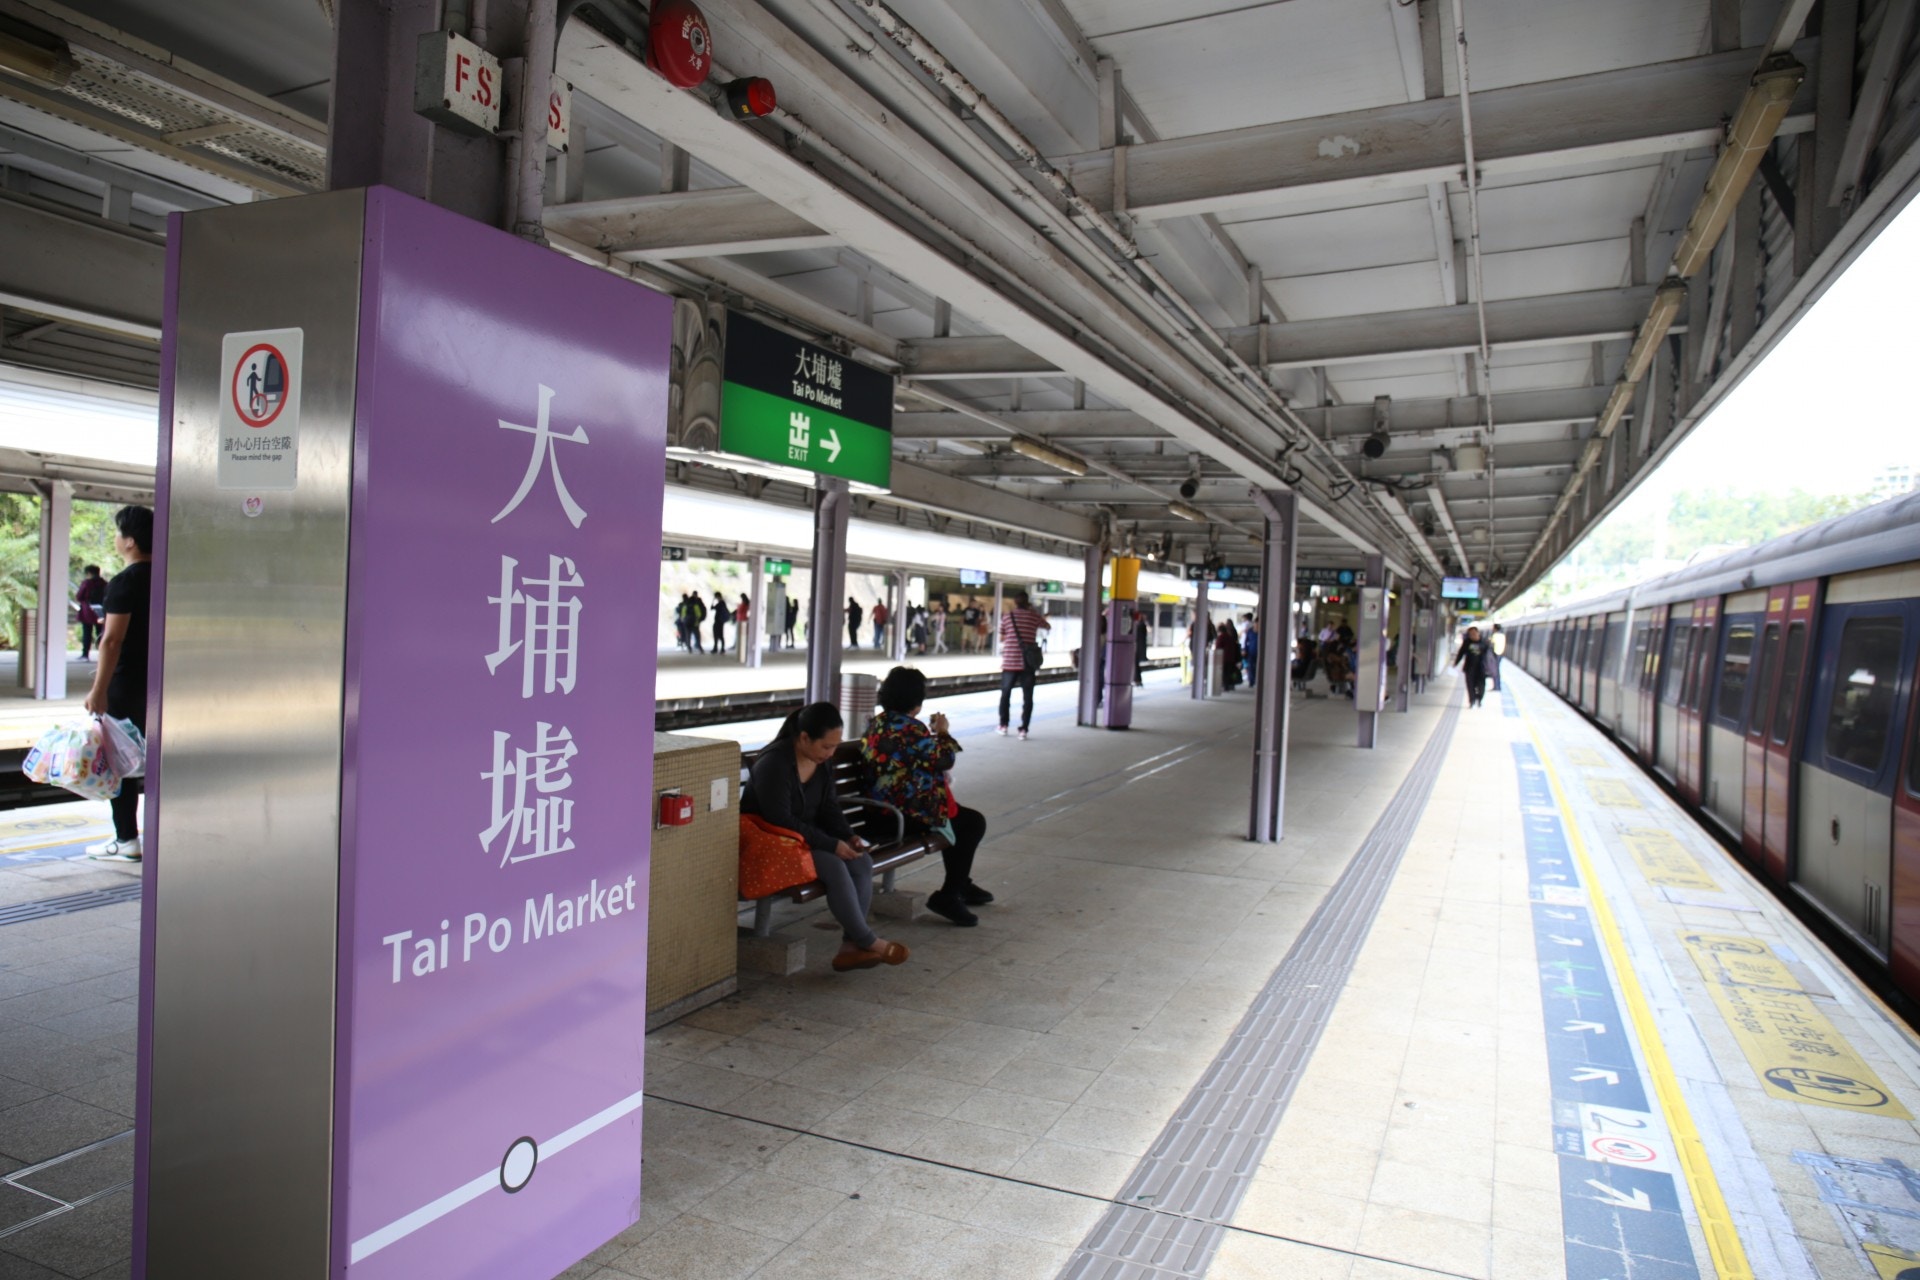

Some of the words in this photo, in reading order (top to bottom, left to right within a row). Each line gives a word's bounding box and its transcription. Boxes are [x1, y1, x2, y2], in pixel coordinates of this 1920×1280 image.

[455, 53, 498, 111] F.S.
[794, 347, 843, 391] 大埔墟
[792, 380, 804, 398] Tai
[804, 384, 816, 401] Po
[815, 388, 842, 410] Market
[789, 411, 810, 449] 出
[231, 453, 248, 461] Please
[247, 453, 262, 461] mind
[262, 453, 271, 461] the
[271, 454, 282, 462] gap
[788, 445, 808, 462] EXIT
[478, 383, 591, 869] 大埔墟
[382, 919, 450, 984] Tai
[463, 912, 512, 962] Po
[522, 874, 637, 944] Market
